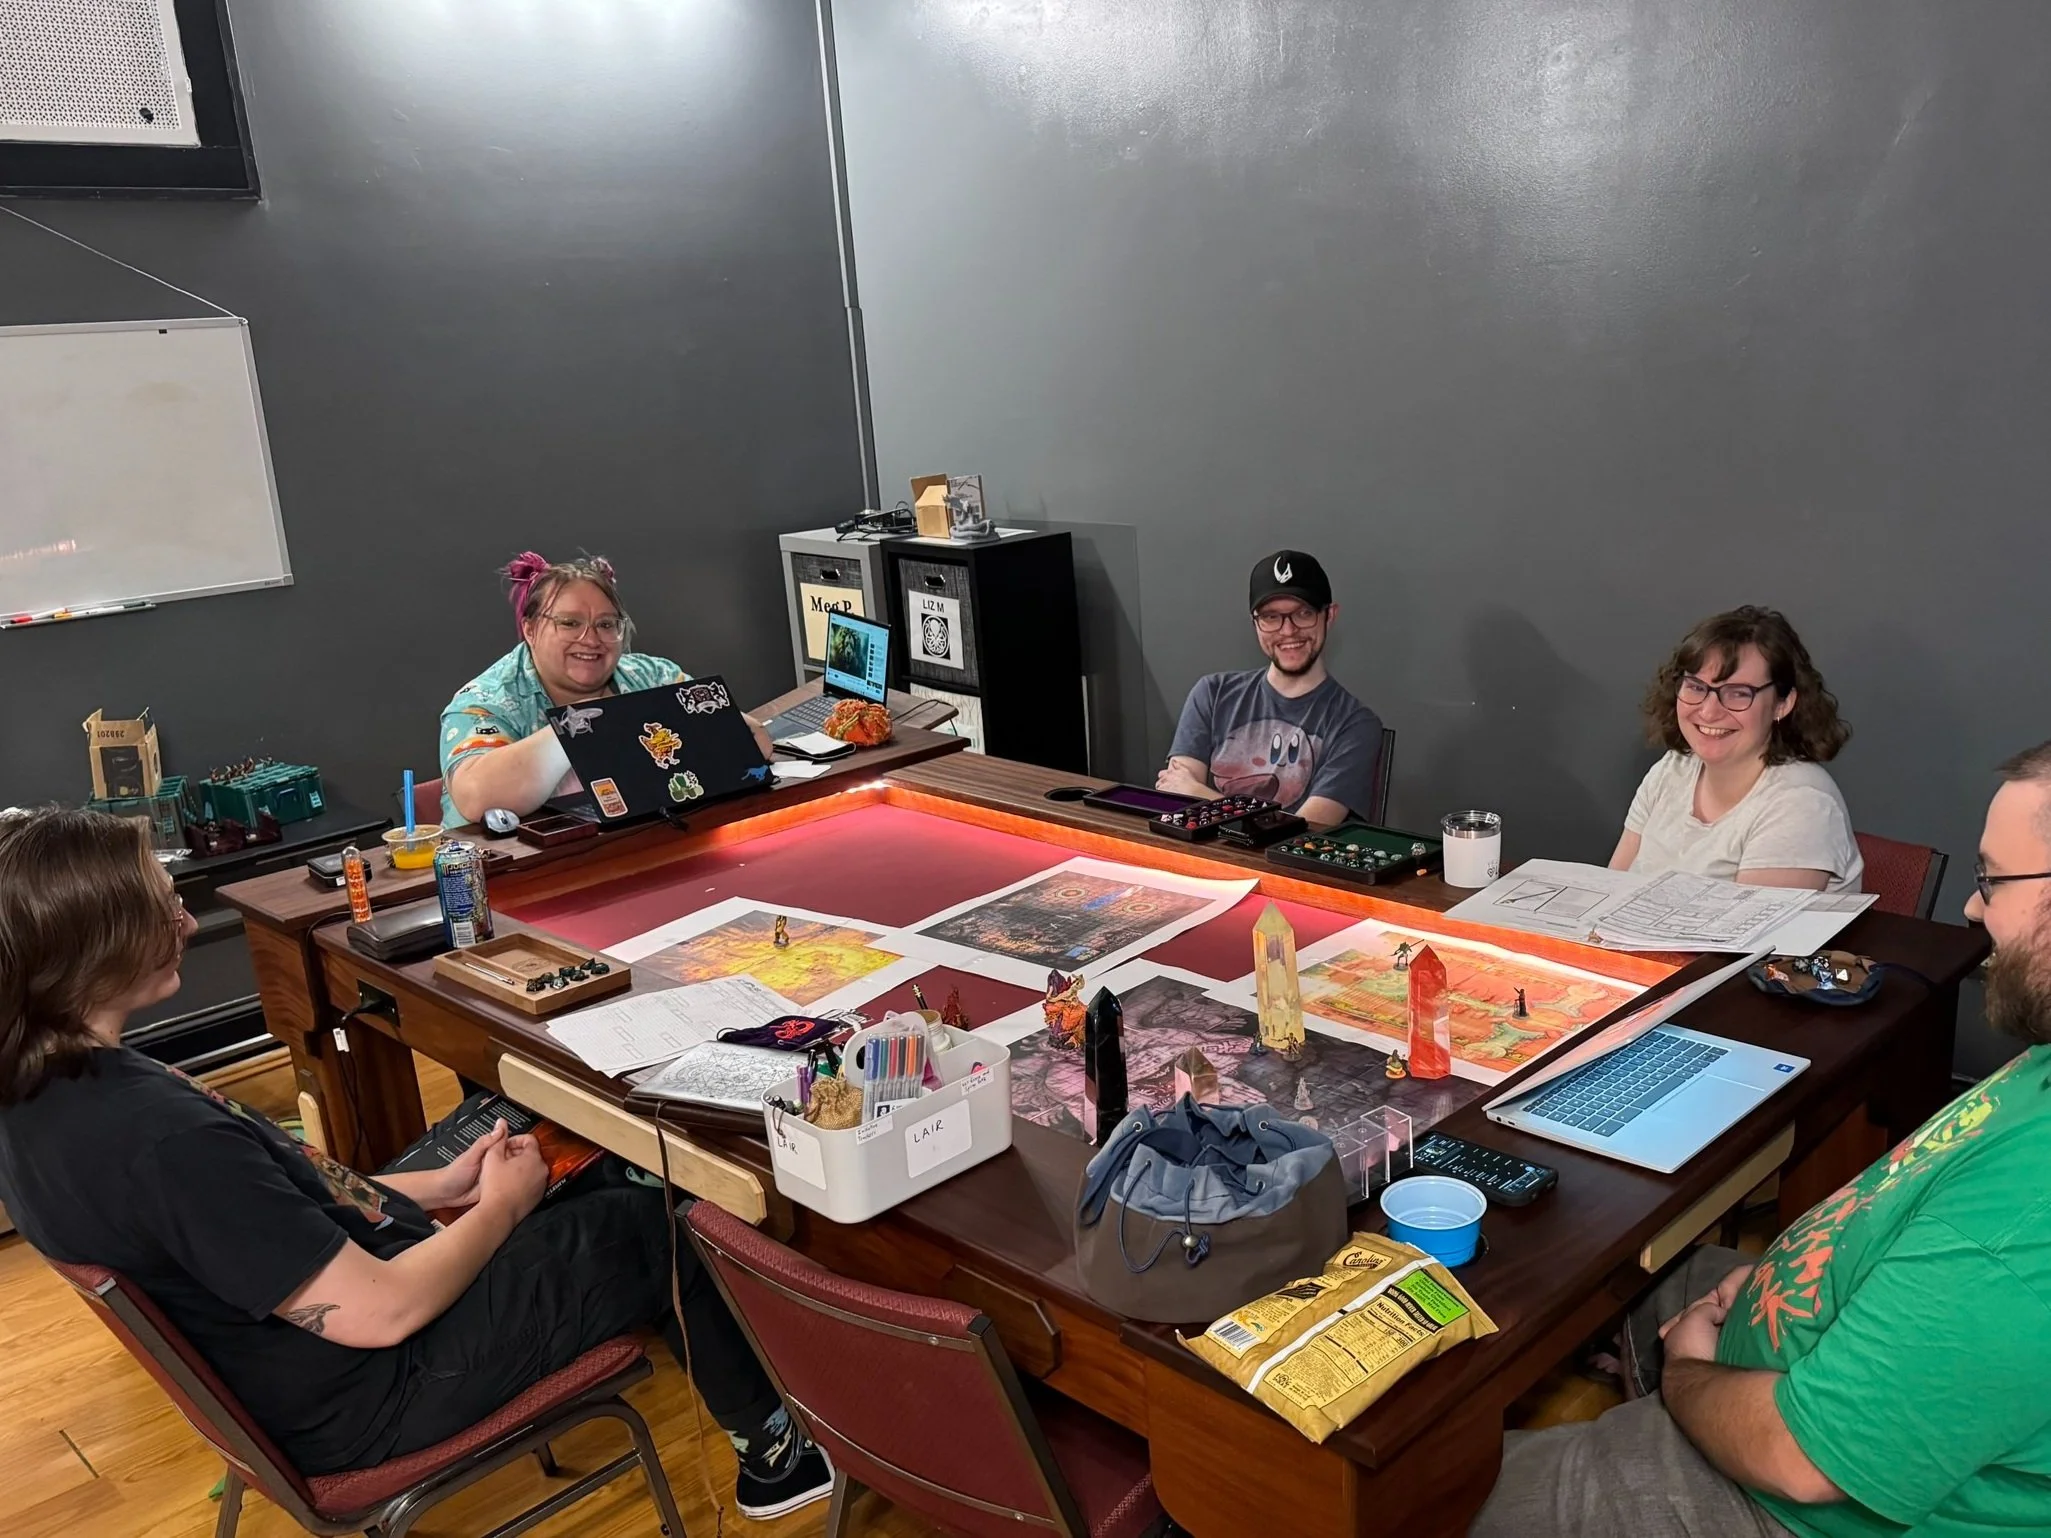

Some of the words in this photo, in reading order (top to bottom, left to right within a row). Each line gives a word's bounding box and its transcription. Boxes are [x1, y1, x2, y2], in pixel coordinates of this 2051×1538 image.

[923, 599, 935, 612] LIZ
[937, 602, 945, 613] M
[913, 1119, 944, 1143] LAIR
[777, 1136, 797, 1154] LAIR
[1343, 1251, 1384, 1270] Carolina
[1376, 1300, 1405, 1326] Nutrition
[1404, 1320, 1425, 1339] Facts
